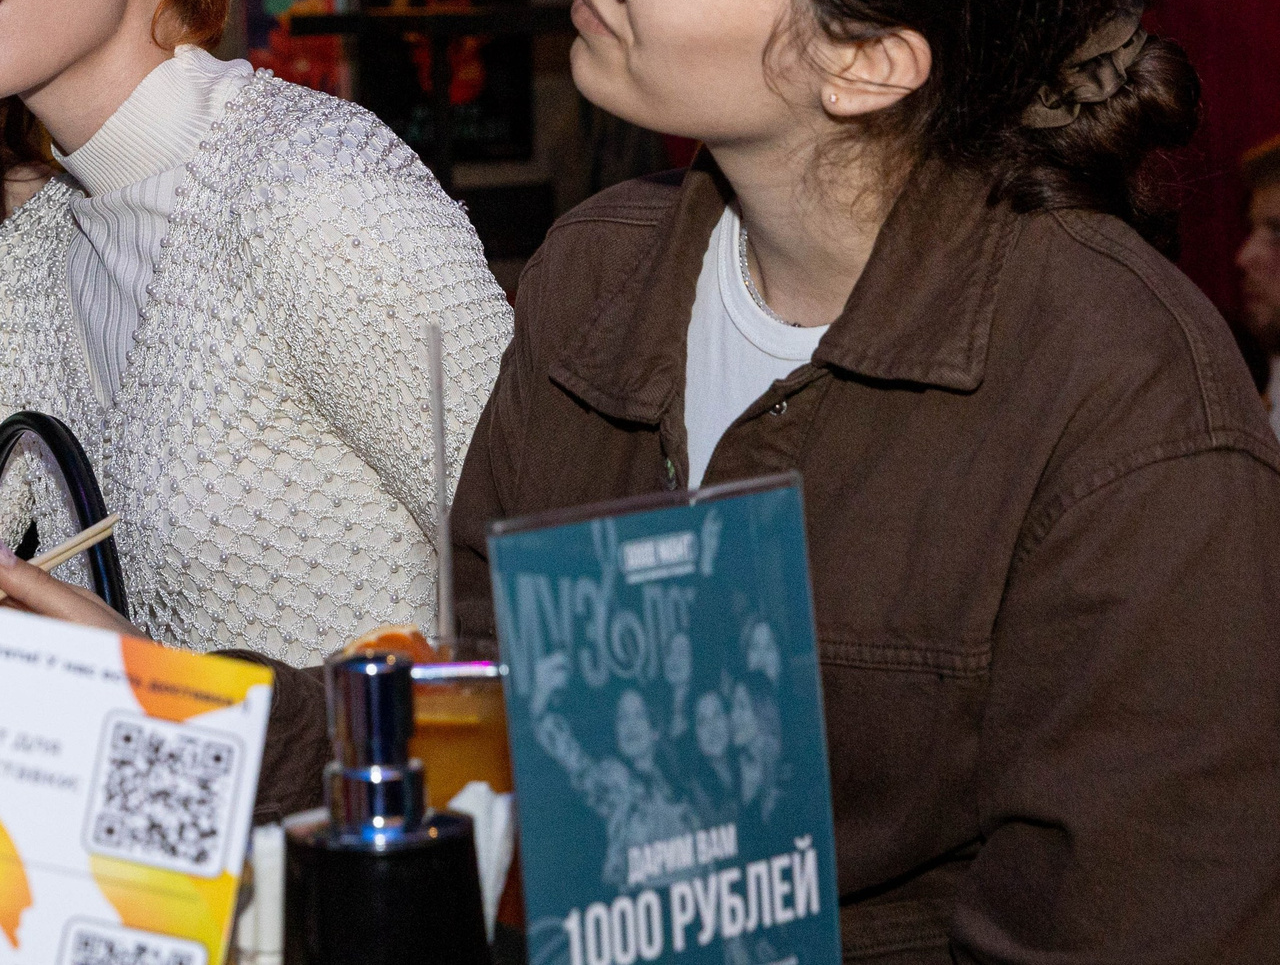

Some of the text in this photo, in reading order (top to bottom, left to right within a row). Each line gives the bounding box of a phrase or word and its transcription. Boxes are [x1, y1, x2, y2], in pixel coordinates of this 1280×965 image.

[696, 822, 738, 865] ВАМ
[563, 833, 821, 965] 1000 РУБЛЕЙ
